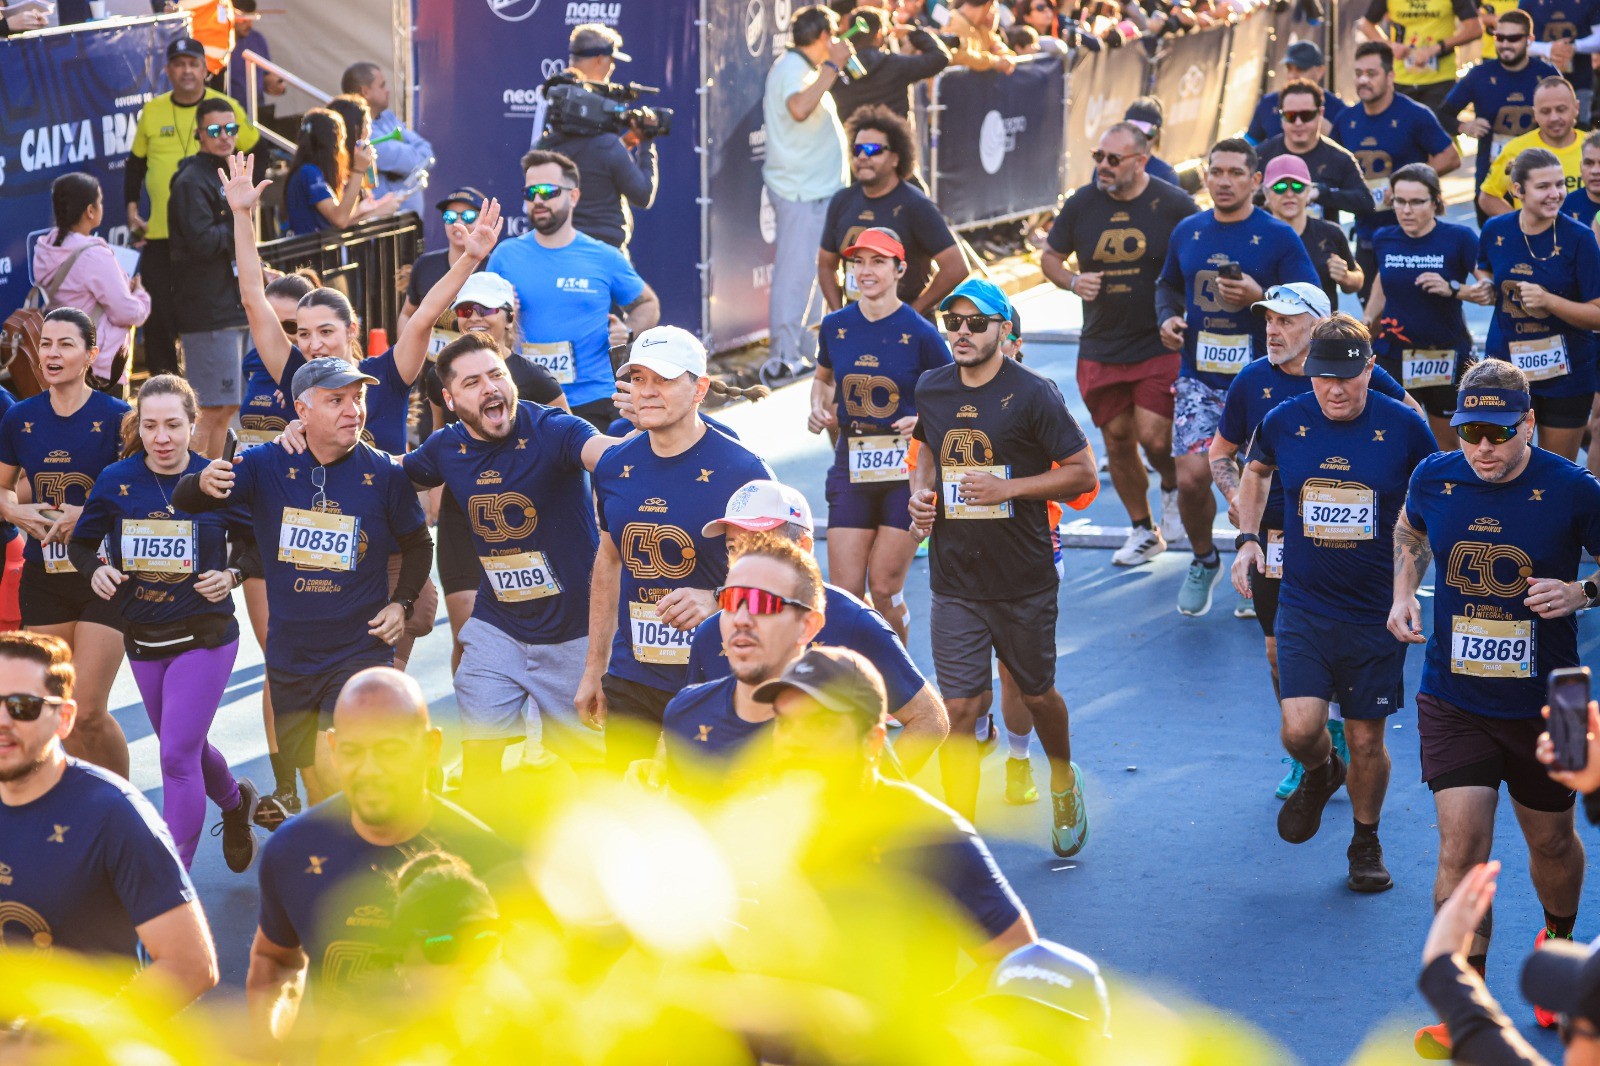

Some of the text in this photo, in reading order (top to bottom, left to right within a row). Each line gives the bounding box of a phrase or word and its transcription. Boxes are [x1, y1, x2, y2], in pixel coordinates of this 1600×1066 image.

[115, 93, 142, 108] GOVERNO
[20, 119, 96, 172] CAIXA
[102, 110, 143, 156] BRA
[1092, 227, 1147, 264] 40
[1203, 345, 1247, 362] 10507
[1518, 350, 1562, 369] 3066-2
[1411, 360, 1450, 377] 14010
[856, 449, 905, 469] 13847
[1320, 463, 1351, 471] OLYMPIKUS
[638, 505, 669, 514] OLYMPIKUS
[1310, 505, 1370, 524] 3022-2
[1468, 524, 1502, 533] OLYMPIKUS
[133, 537, 187, 558] 11536
[288, 526, 349, 554] 10836
[494, 568, 545, 590] 12169
[304, 585, 341, 594] INTEGRAÇÃO
[1475, 611, 1513, 621] INTEGRAÇÃO
[1476, 604, 1503, 612] CORRIDA
[1461, 635, 1527, 662] 13869
